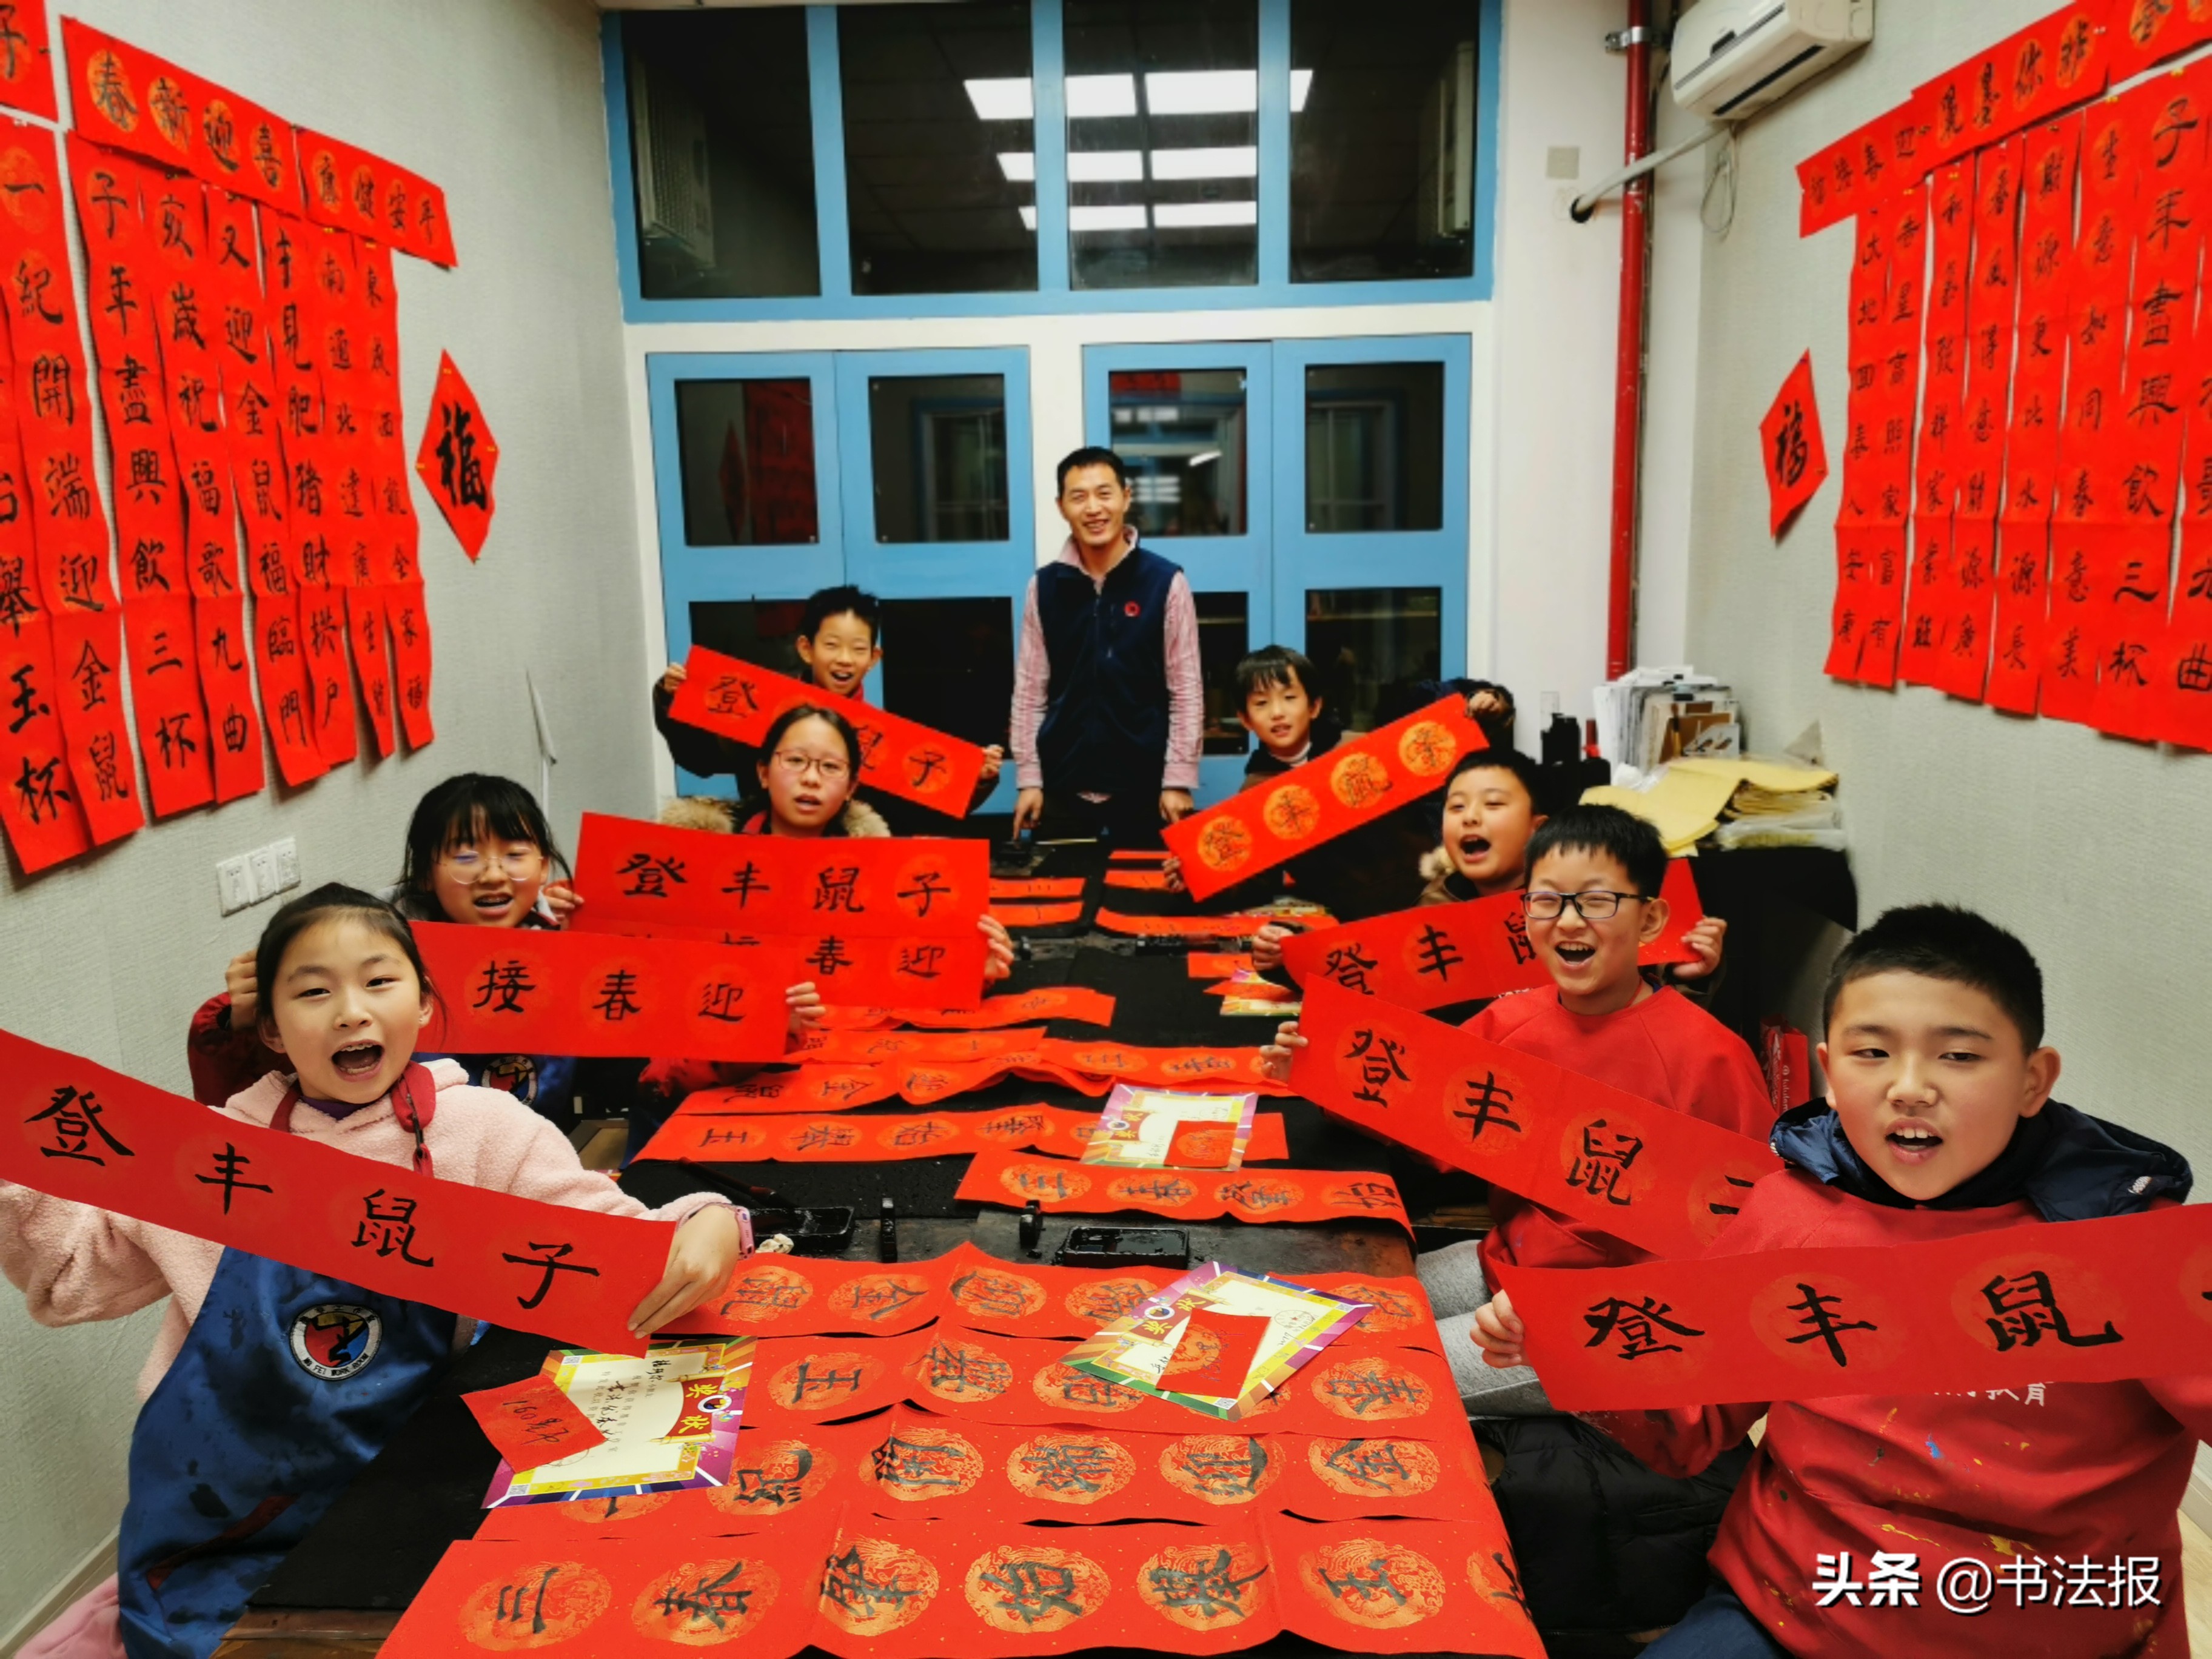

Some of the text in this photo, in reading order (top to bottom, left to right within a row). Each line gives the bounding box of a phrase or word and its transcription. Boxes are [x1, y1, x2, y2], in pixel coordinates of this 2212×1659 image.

[436, 400, 487, 511] 福
[1776, 400, 1808, 488] 福
[677, 1383, 719, 1435] 奖状
